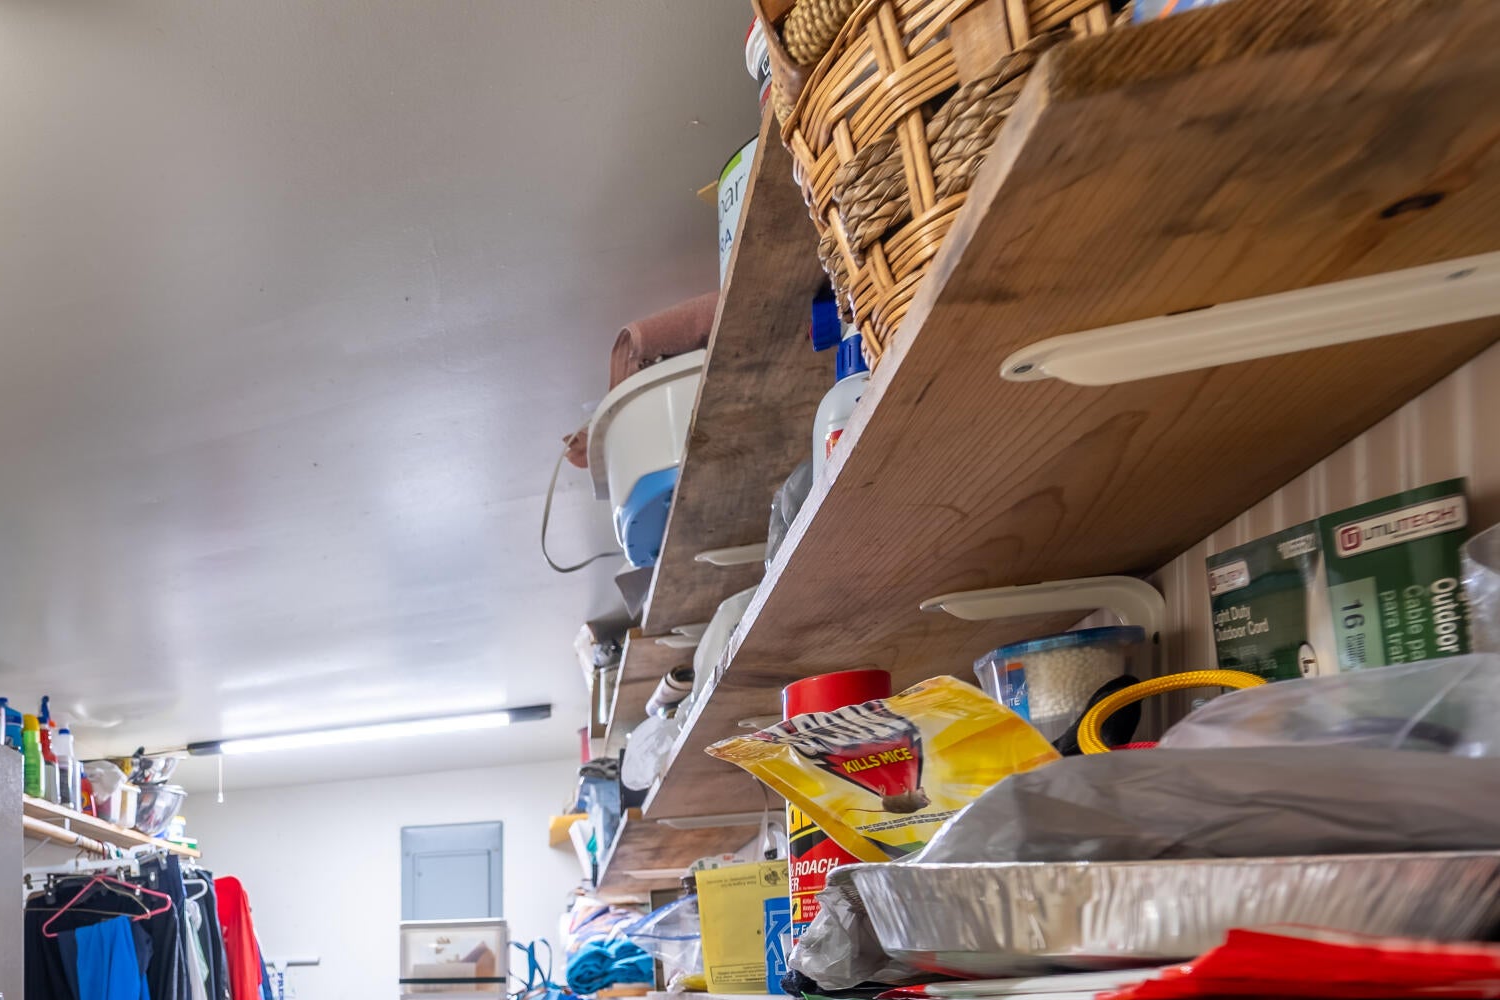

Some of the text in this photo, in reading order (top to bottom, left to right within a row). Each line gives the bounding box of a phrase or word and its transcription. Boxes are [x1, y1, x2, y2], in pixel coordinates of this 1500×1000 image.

[1363, 505, 1457, 541] UTILITECH
[1230, 605, 1251, 620] Duty
[1340, 599, 1365, 629] 16
[1378, 590, 1400, 628] para
[1402, 585, 1428, 635] Cable
[1431, 577, 1459, 652] Outdoor
[1247, 616, 1270, 635] Cord
[842, 747, 914, 774] KILLS MICE
[795, 858, 839, 877] ROACH
